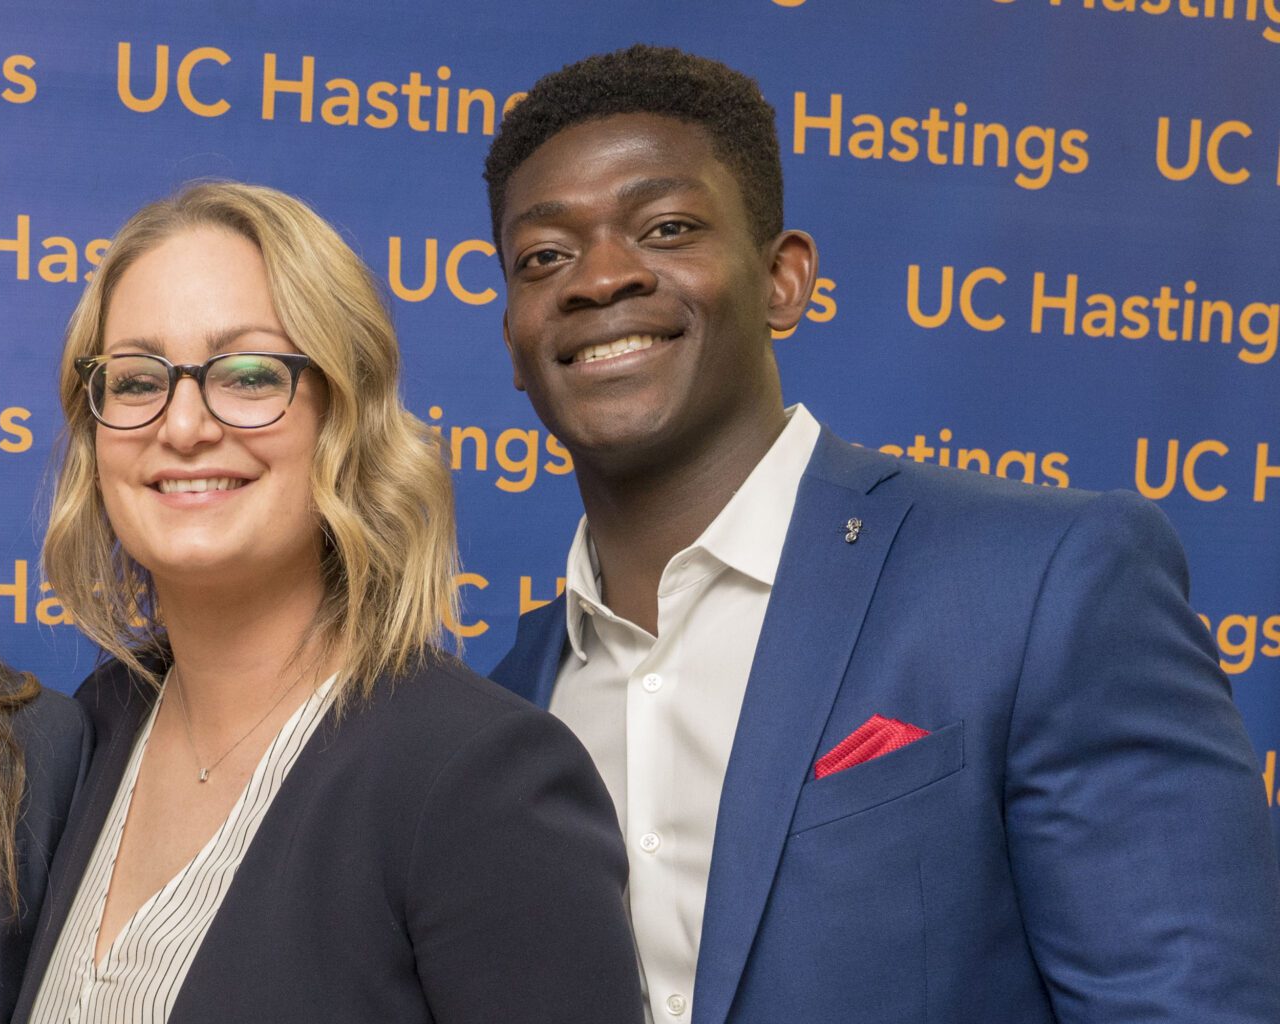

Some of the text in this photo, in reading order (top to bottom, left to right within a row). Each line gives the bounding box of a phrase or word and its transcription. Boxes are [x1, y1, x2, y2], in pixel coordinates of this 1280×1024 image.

[117, 41, 232, 118] UC
[793, 91, 1090, 190] Hastings
[1156, 116, 1253, 186] UC
[388, 236, 498, 305] UC
[907, 264, 1007, 332] UC
[1030, 271, 1280, 364] Hasting
[1135, 438, 1229, 502] UC
